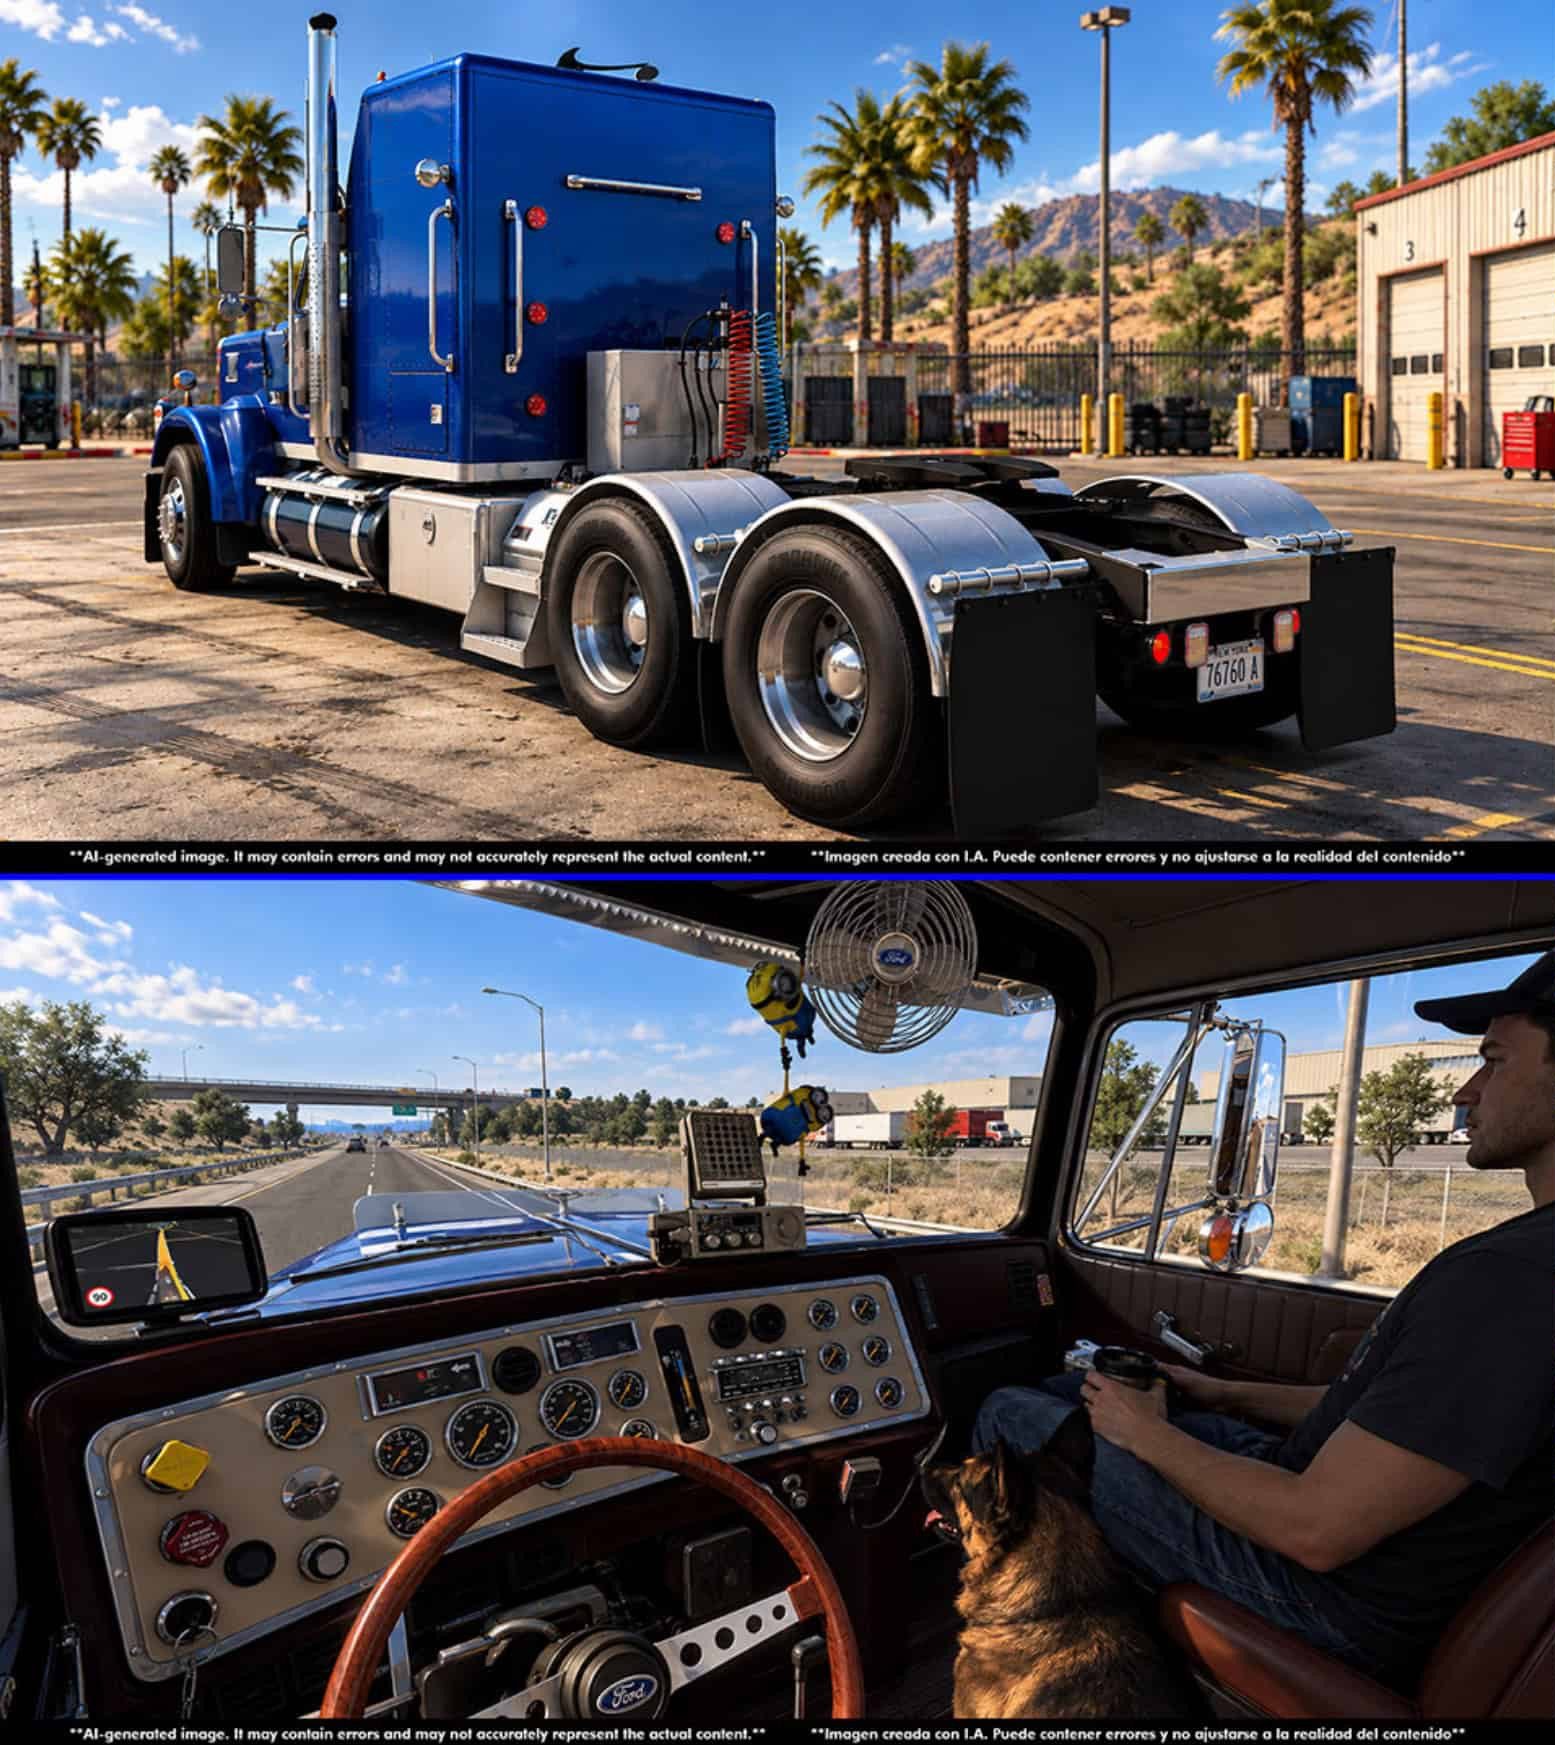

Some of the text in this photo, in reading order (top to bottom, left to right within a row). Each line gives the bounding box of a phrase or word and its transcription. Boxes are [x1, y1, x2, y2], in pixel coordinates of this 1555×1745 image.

[1514, 208, 1527, 237] 4
[1405, 240, 1415, 262] 3
[1207, 655, 1259, 689] 76760 A
[92, 1291, 108, 1303] 90
[612, 1681, 645, 1708] Ford
